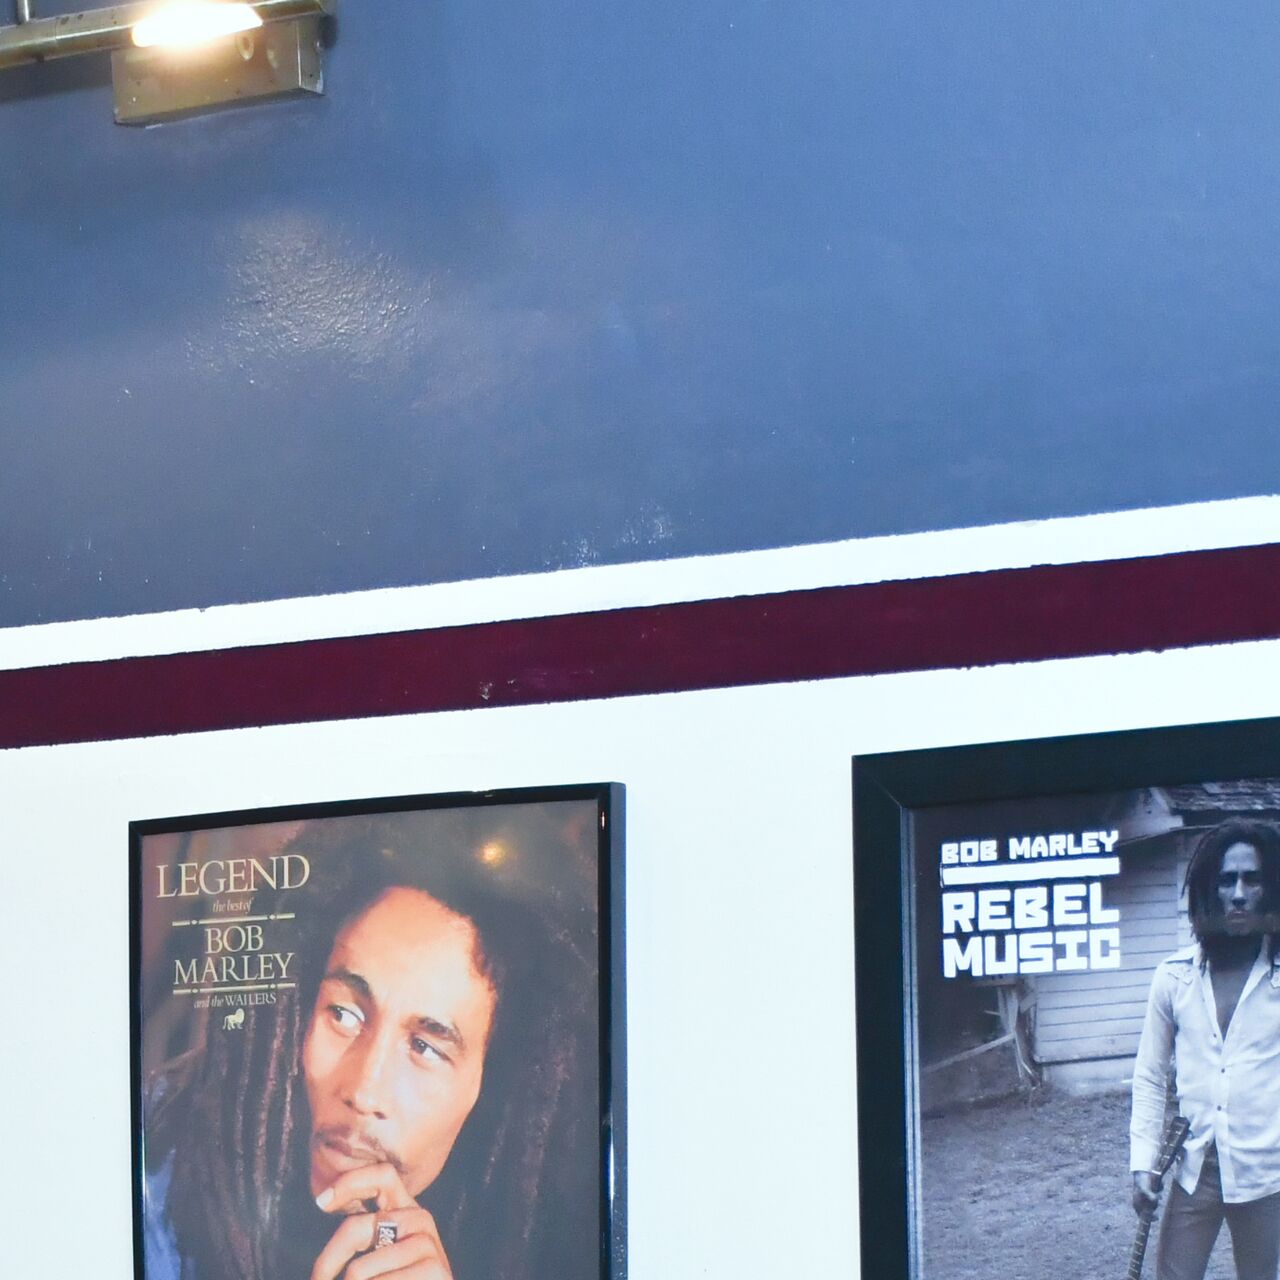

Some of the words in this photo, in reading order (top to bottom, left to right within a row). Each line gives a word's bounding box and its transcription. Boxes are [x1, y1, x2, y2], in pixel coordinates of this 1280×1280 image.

[941, 840, 998, 864] BOB
[1009, 830, 1119, 859] MARLEY
[156, 854, 310, 898] LEGEND
[212, 900, 225, 912] the
[226, 899, 243, 912] best
[942, 882, 1120, 934] REBEL
[205, 924, 264, 954] BOB
[943, 928, 1120, 978] MUSIC
[173, 952, 295, 985] MARLEY
[211, 995, 224, 1008] the
[225, 992, 277, 1007] WAILERS
